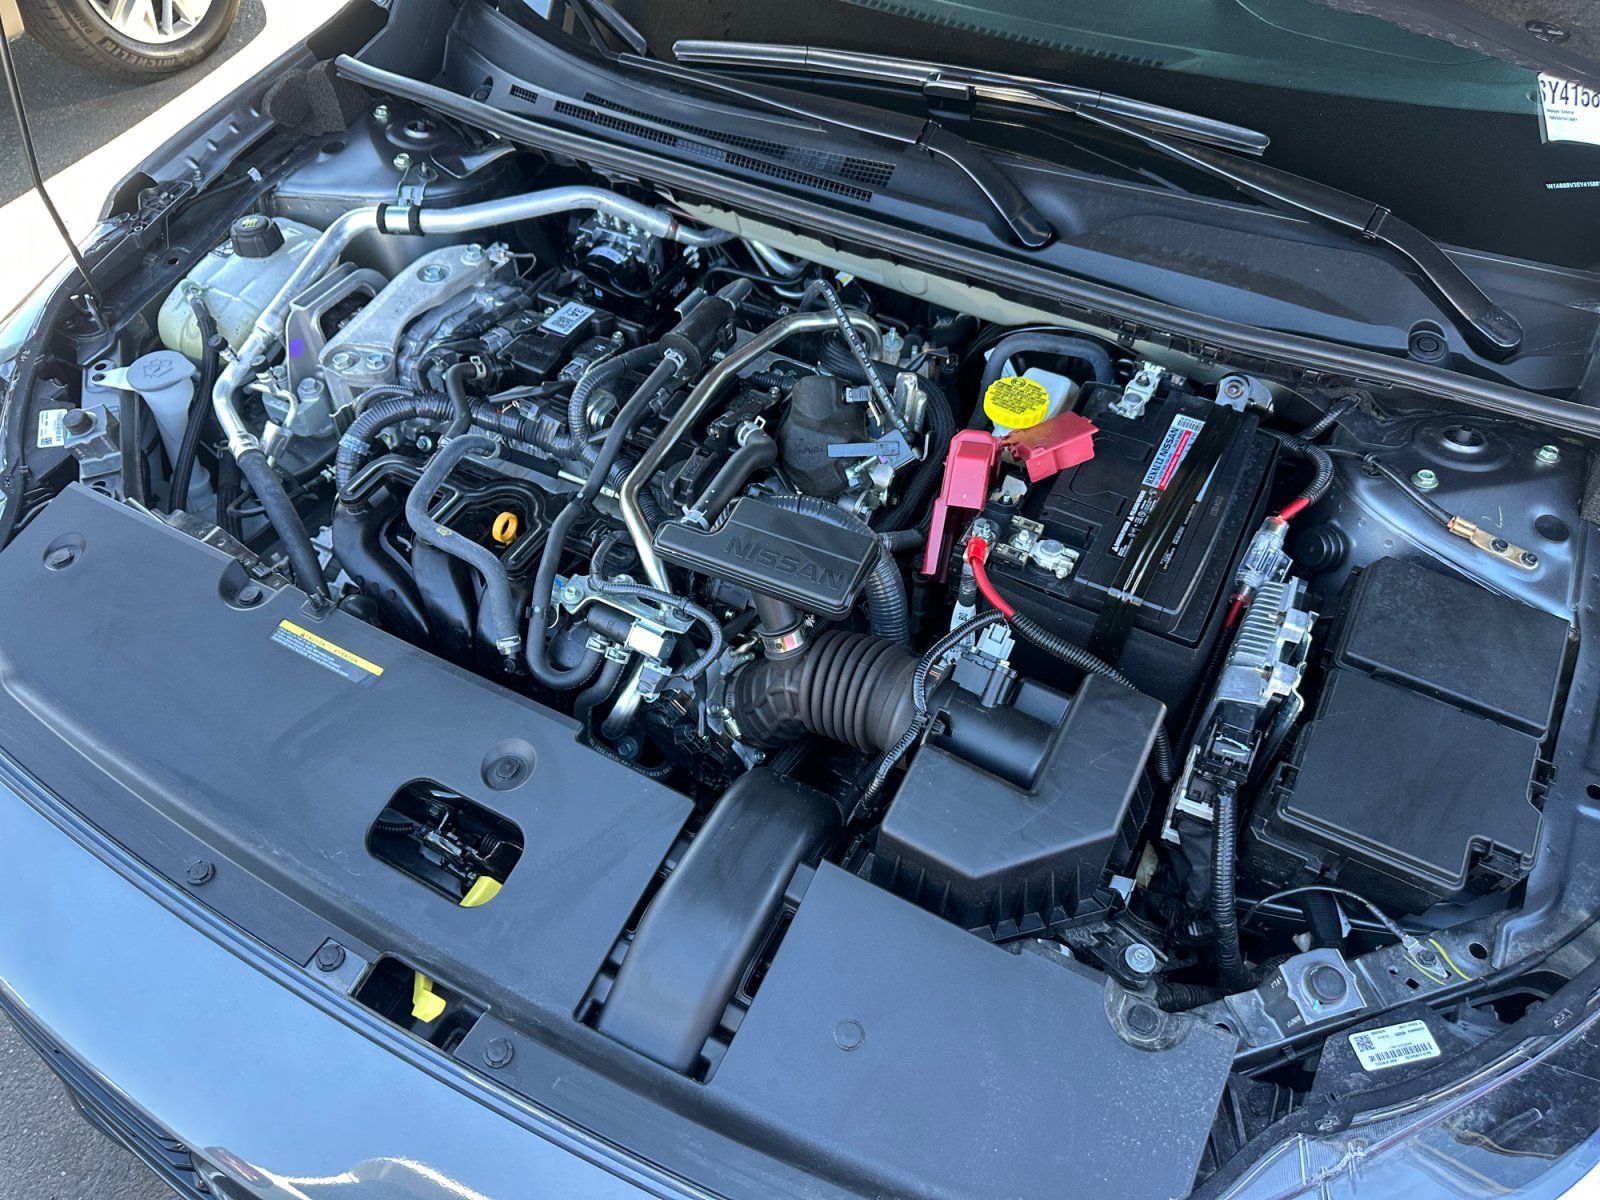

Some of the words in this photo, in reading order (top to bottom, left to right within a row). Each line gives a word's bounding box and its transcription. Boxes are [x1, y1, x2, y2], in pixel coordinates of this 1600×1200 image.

[101, 37, 176, 67] MICHELIN
[1145, 459, 1163, 485] RENAULT
[1161, 427, 1180, 458] NISSAN
[724, 536, 844, 591] NISSAN
